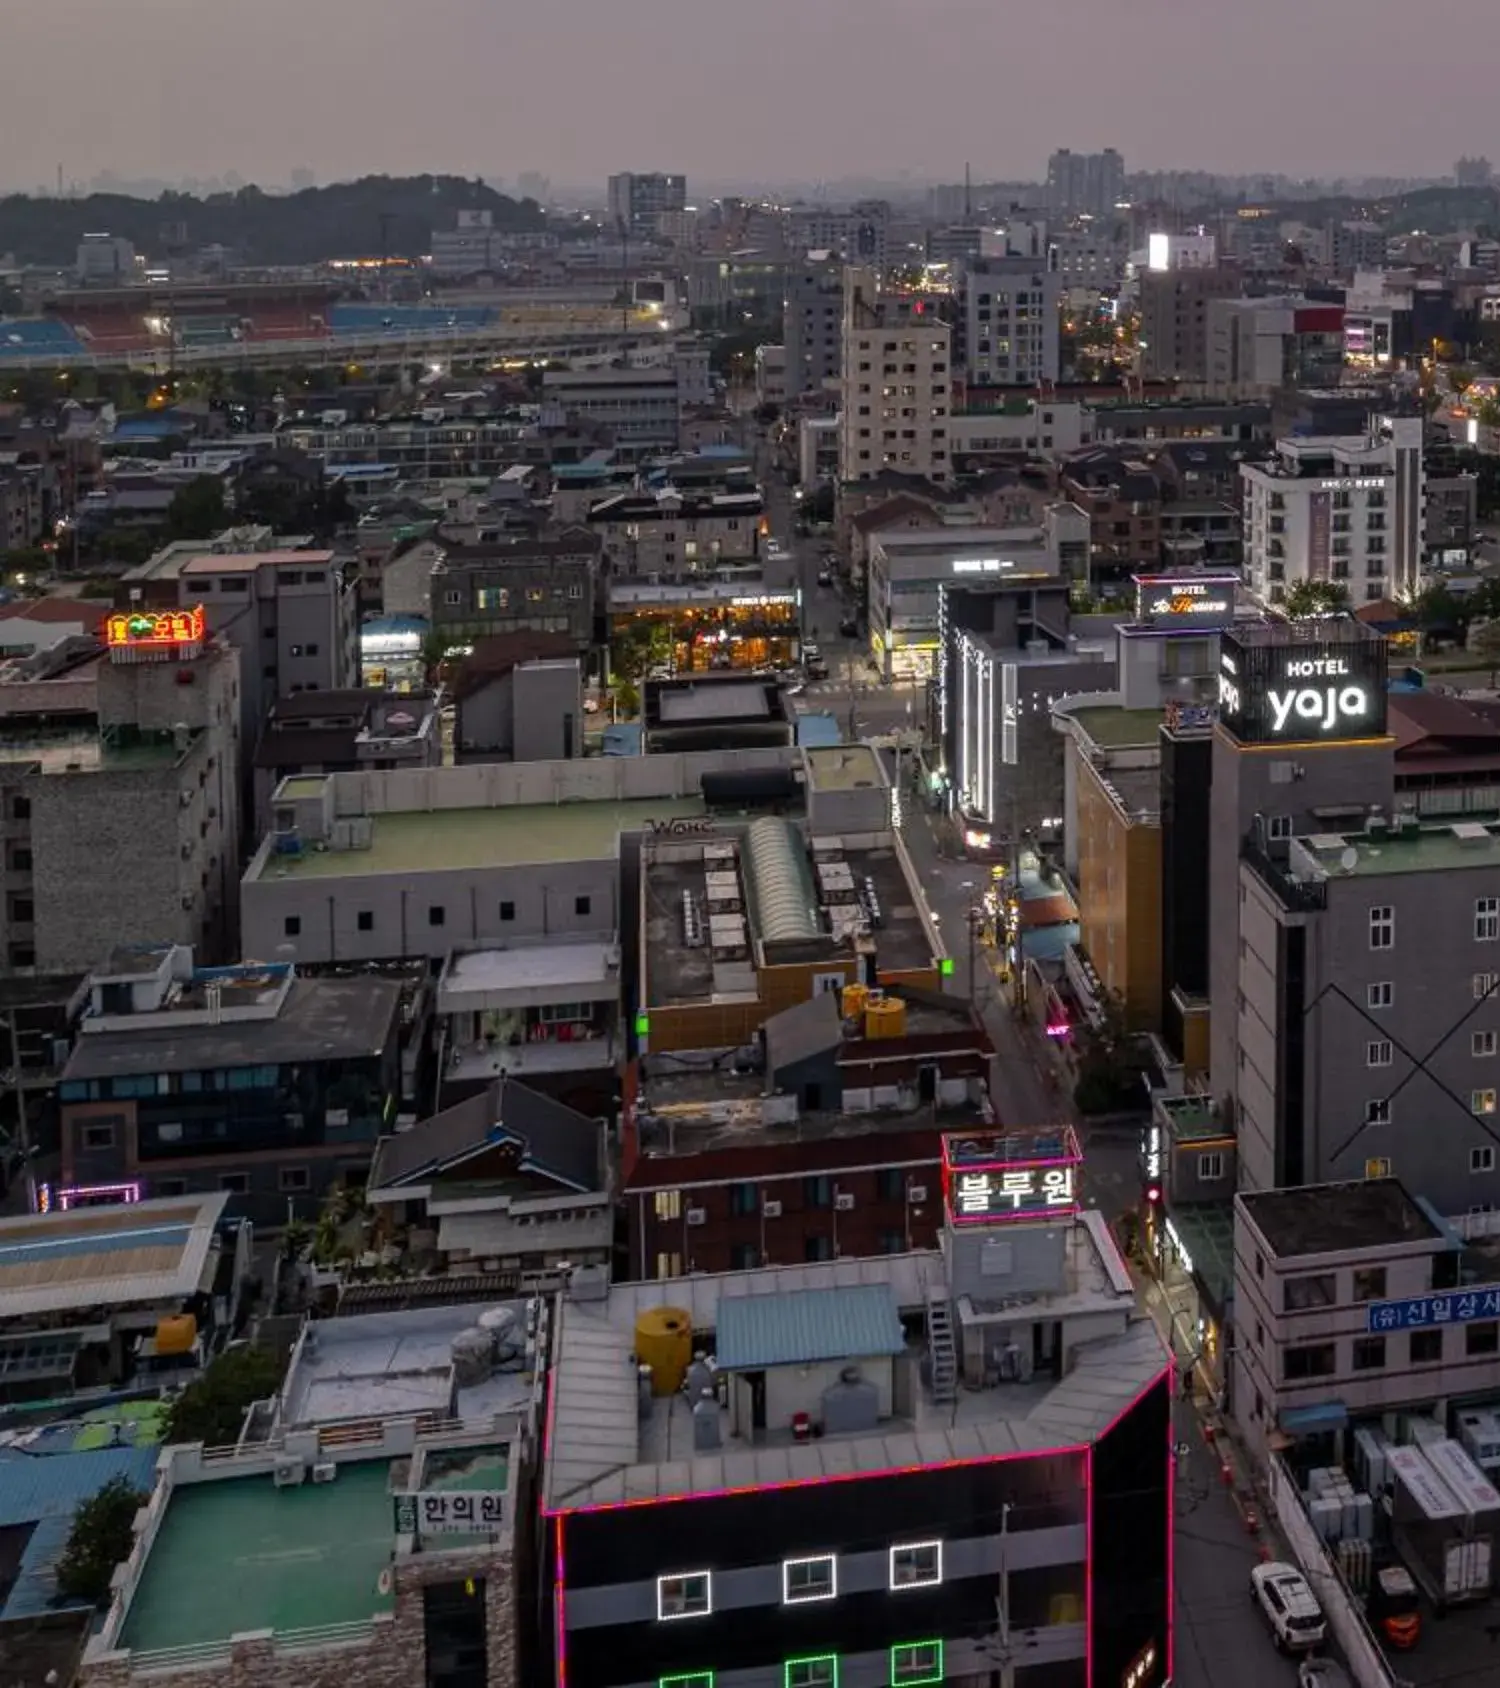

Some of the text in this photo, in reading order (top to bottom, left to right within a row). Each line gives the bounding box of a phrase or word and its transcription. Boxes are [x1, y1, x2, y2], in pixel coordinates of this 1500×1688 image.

[1287, 660, 1349, 677] HOTEL
[1267, 686, 1368, 731] yaja
[958, 1167, 1073, 1212] 블루원
[424, 1495, 503, 1523] 한의원
